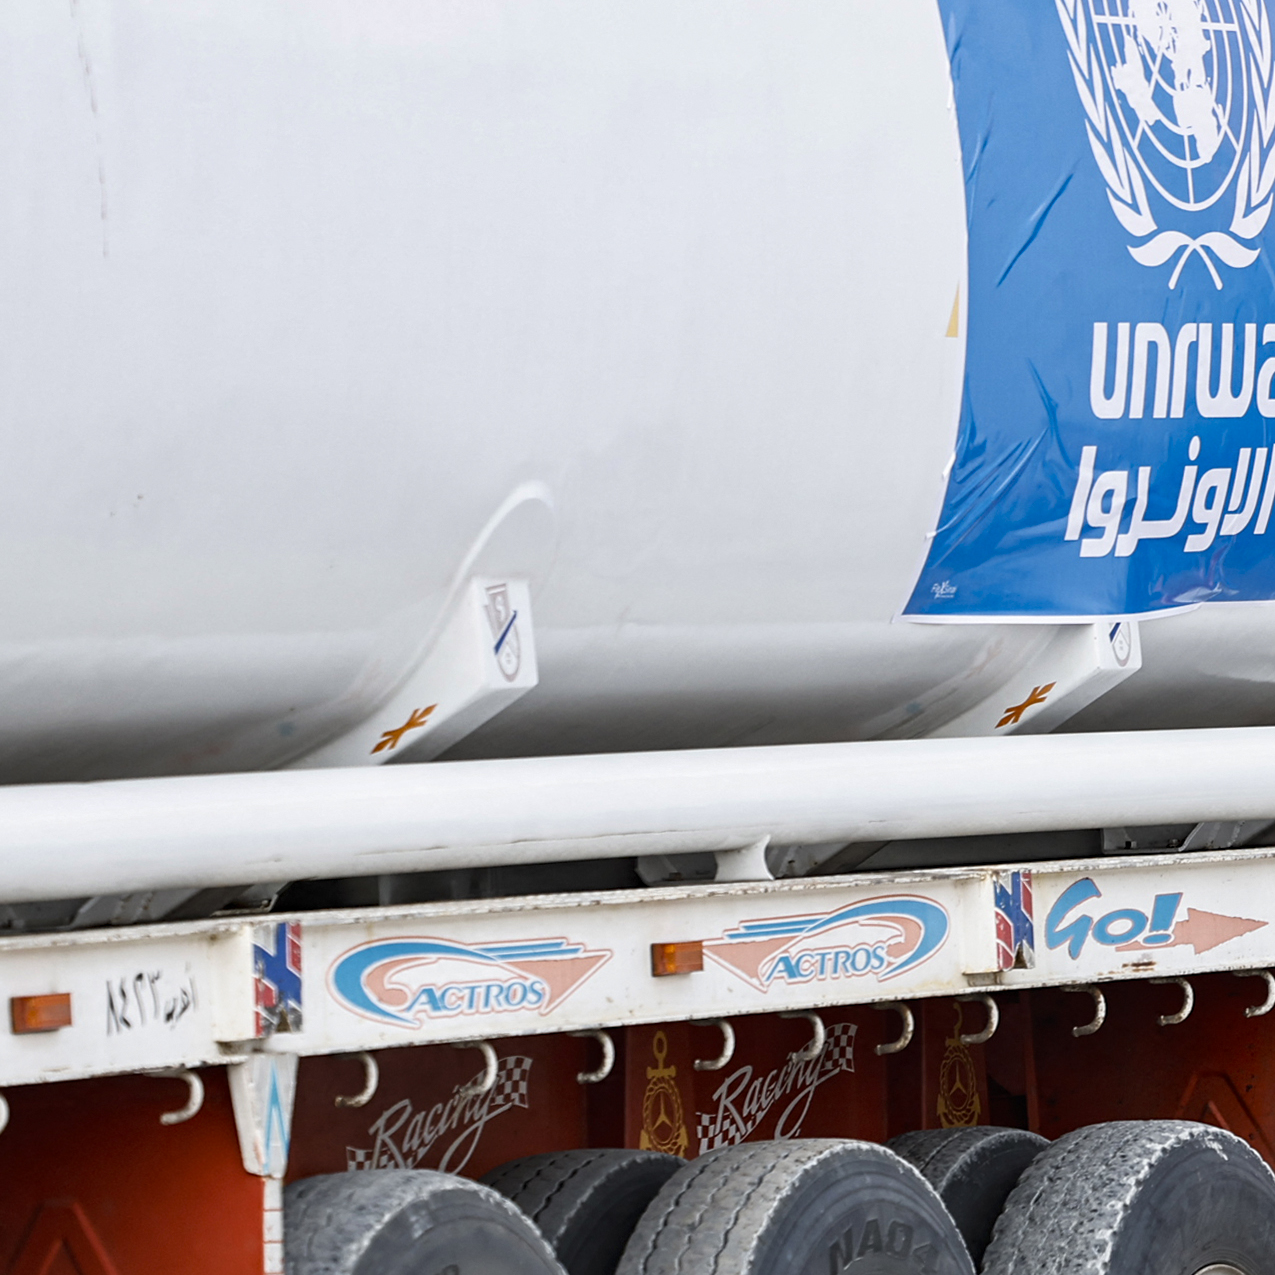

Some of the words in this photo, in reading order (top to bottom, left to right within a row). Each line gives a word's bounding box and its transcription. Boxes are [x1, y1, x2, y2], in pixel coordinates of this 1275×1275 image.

[407, 979, 545, 1014] ACTROS
[765, 943, 888, 982] ACTROS
[368, 1075, 513, 1175] Racing
[712, 1042, 841, 1141] Racing
